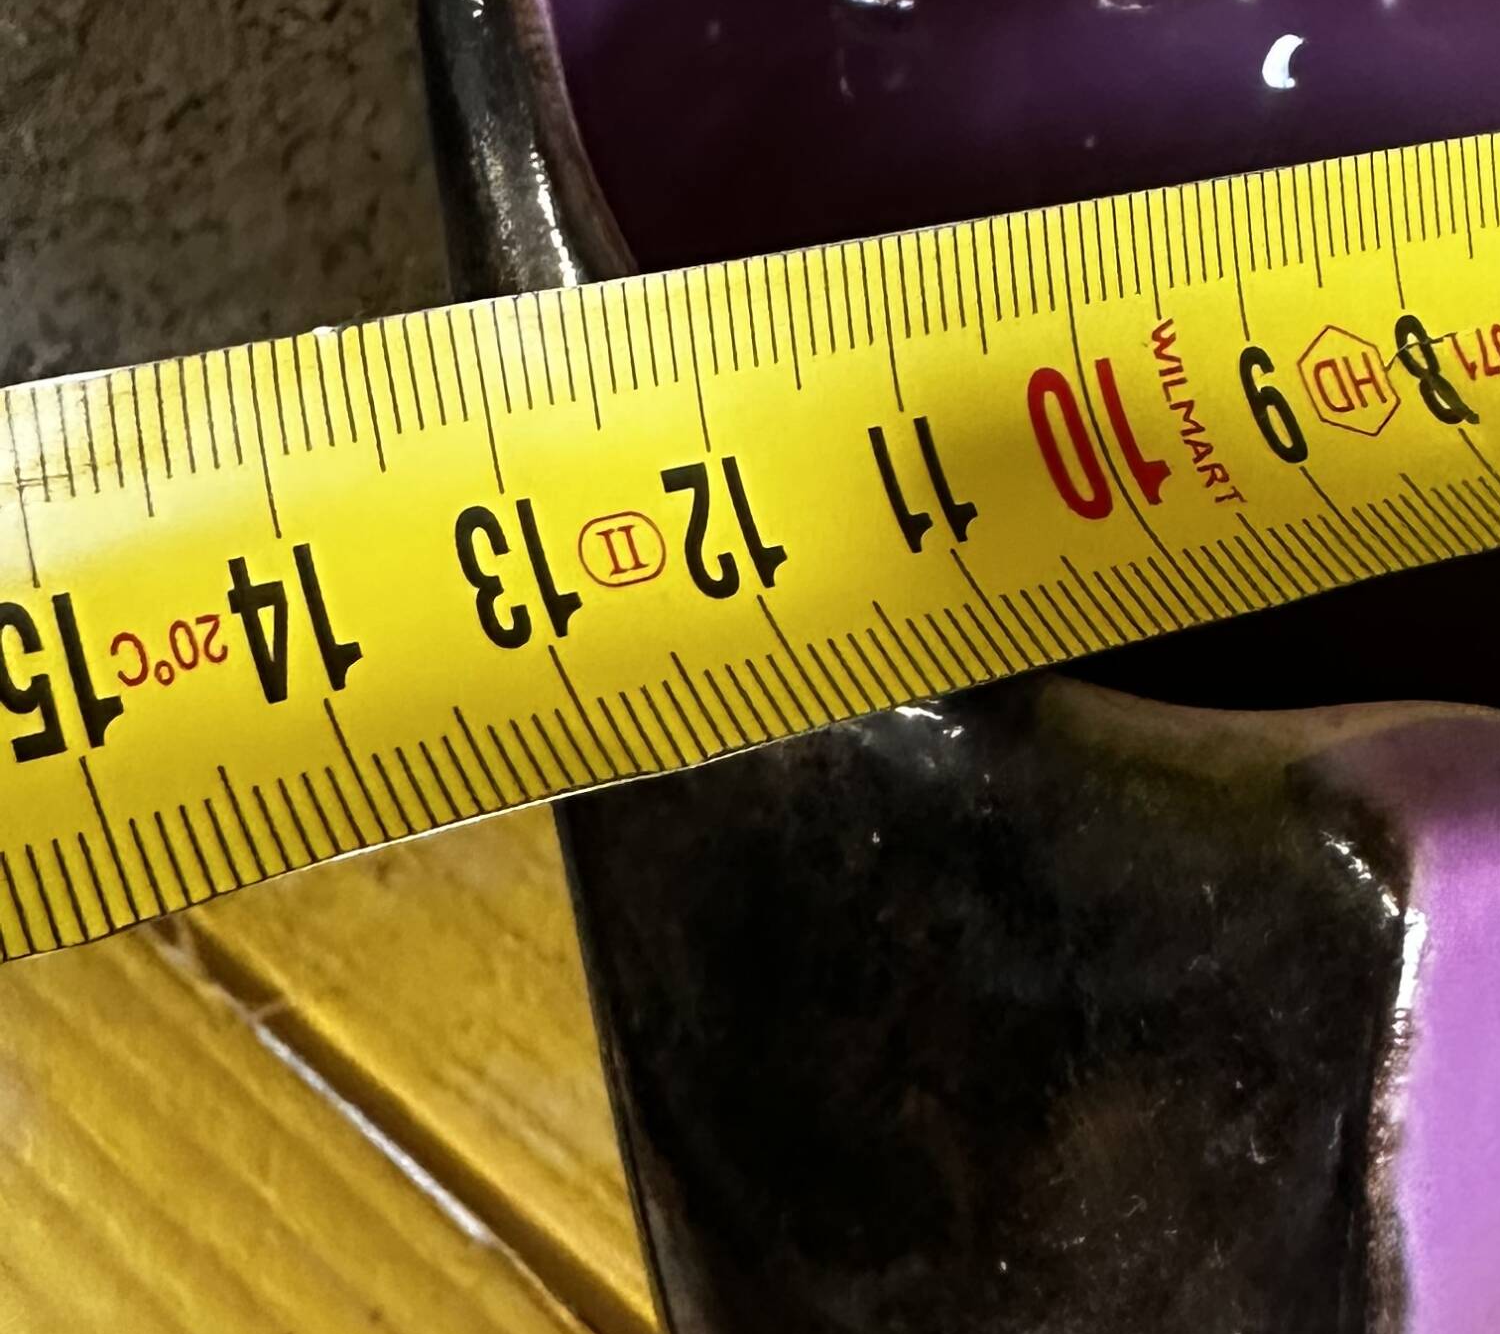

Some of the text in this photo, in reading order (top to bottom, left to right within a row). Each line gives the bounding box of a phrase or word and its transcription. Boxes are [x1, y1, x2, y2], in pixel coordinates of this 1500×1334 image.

[1026, 357, 1173, 521] 10
[1149, 317, 1249, 505] WILMART
[1238, 345, 1309, 464] 9
[1312, 351, 1388, 413] HD
[1394, 313, 1478, 425] 8
[660, 455, 788, 599] 12
[867, 416, 979, 554] 11
[227, 543, 363, 705] 14
[455, 498, 583, 649] 13
[0, 591, 125, 764] 15
[110, 613, 229, 687] 20°C
